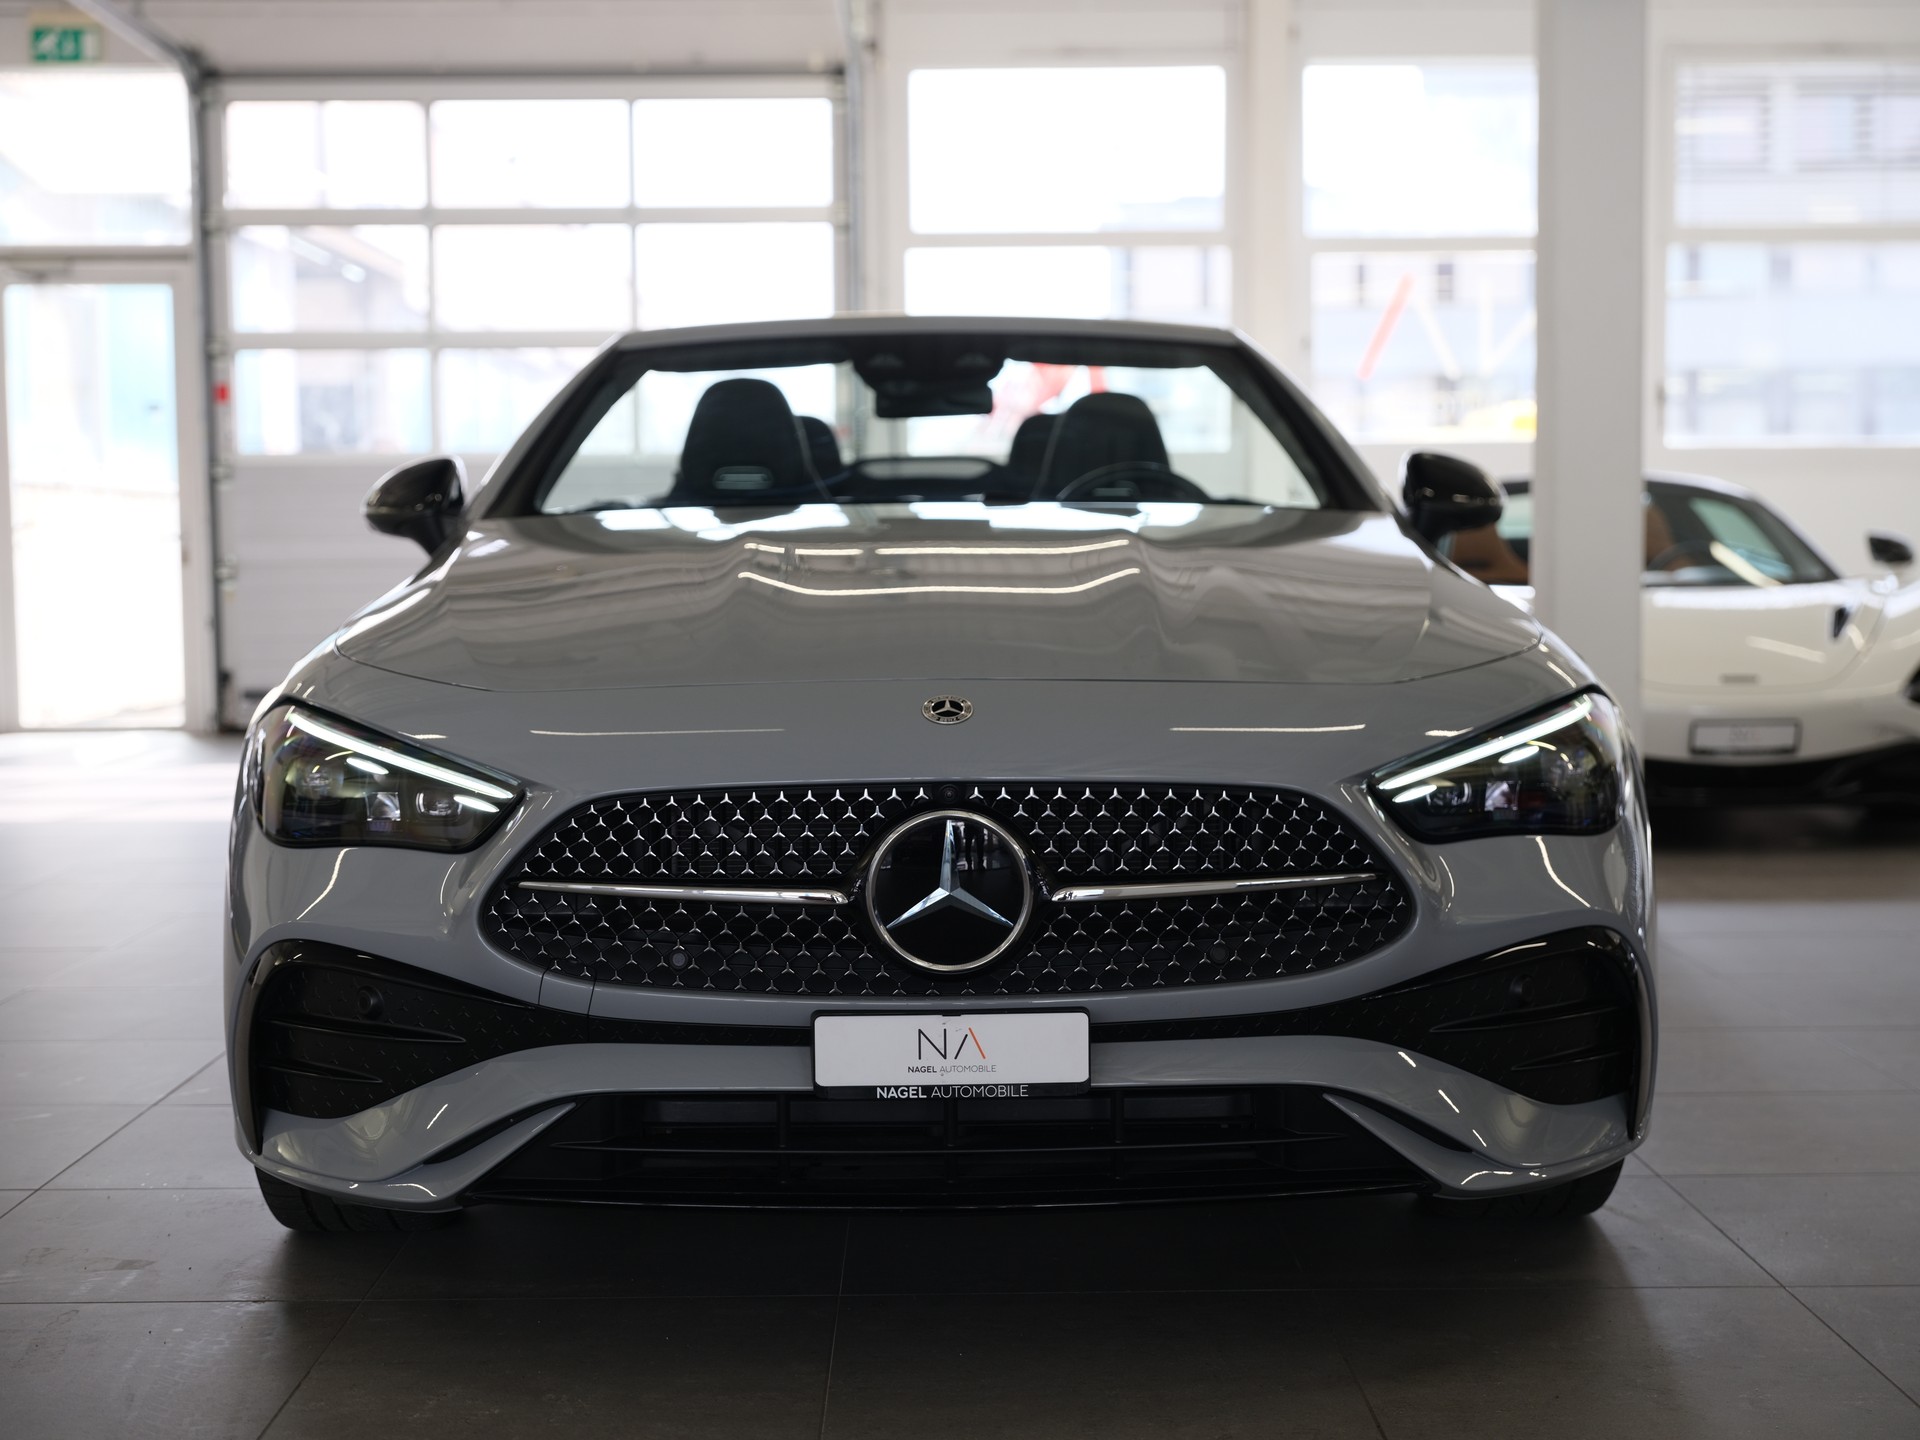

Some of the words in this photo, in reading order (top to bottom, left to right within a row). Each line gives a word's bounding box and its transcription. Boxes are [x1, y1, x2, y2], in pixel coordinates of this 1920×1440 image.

[907, 1066, 937, 1074] NAGEL
[939, 1064, 997, 1073] AUTOMOBILE
[876, 1086, 927, 1099] NAGEL
[930, 1084, 1029, 1098] AUTOMOBILE
